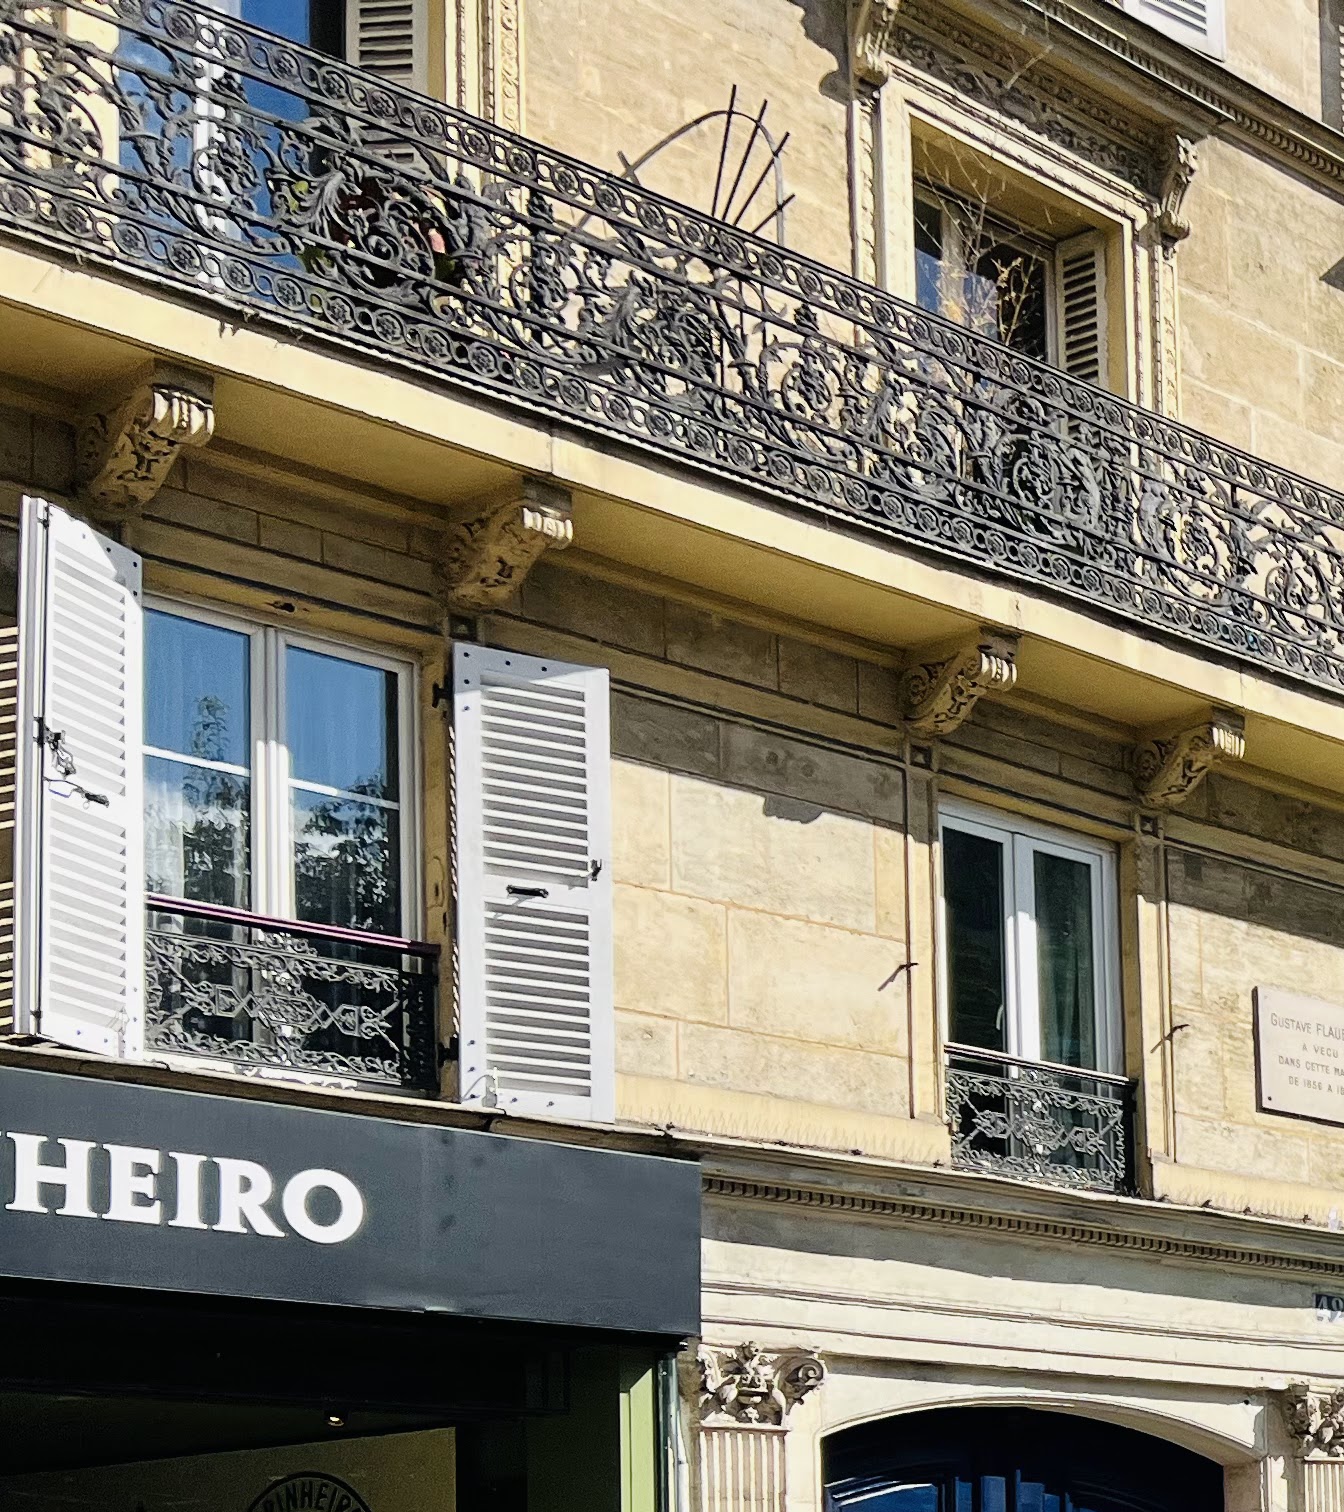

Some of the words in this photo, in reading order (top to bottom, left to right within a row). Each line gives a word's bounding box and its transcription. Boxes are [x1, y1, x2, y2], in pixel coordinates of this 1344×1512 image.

[1270, 1012, 1312, 1035] GUSTAVE
[1278, 1055, 1301, 1069] DANS
[1305, 1060, 1330, 1074] CETTE
[1288, 1075, 1299, 1086] DE
